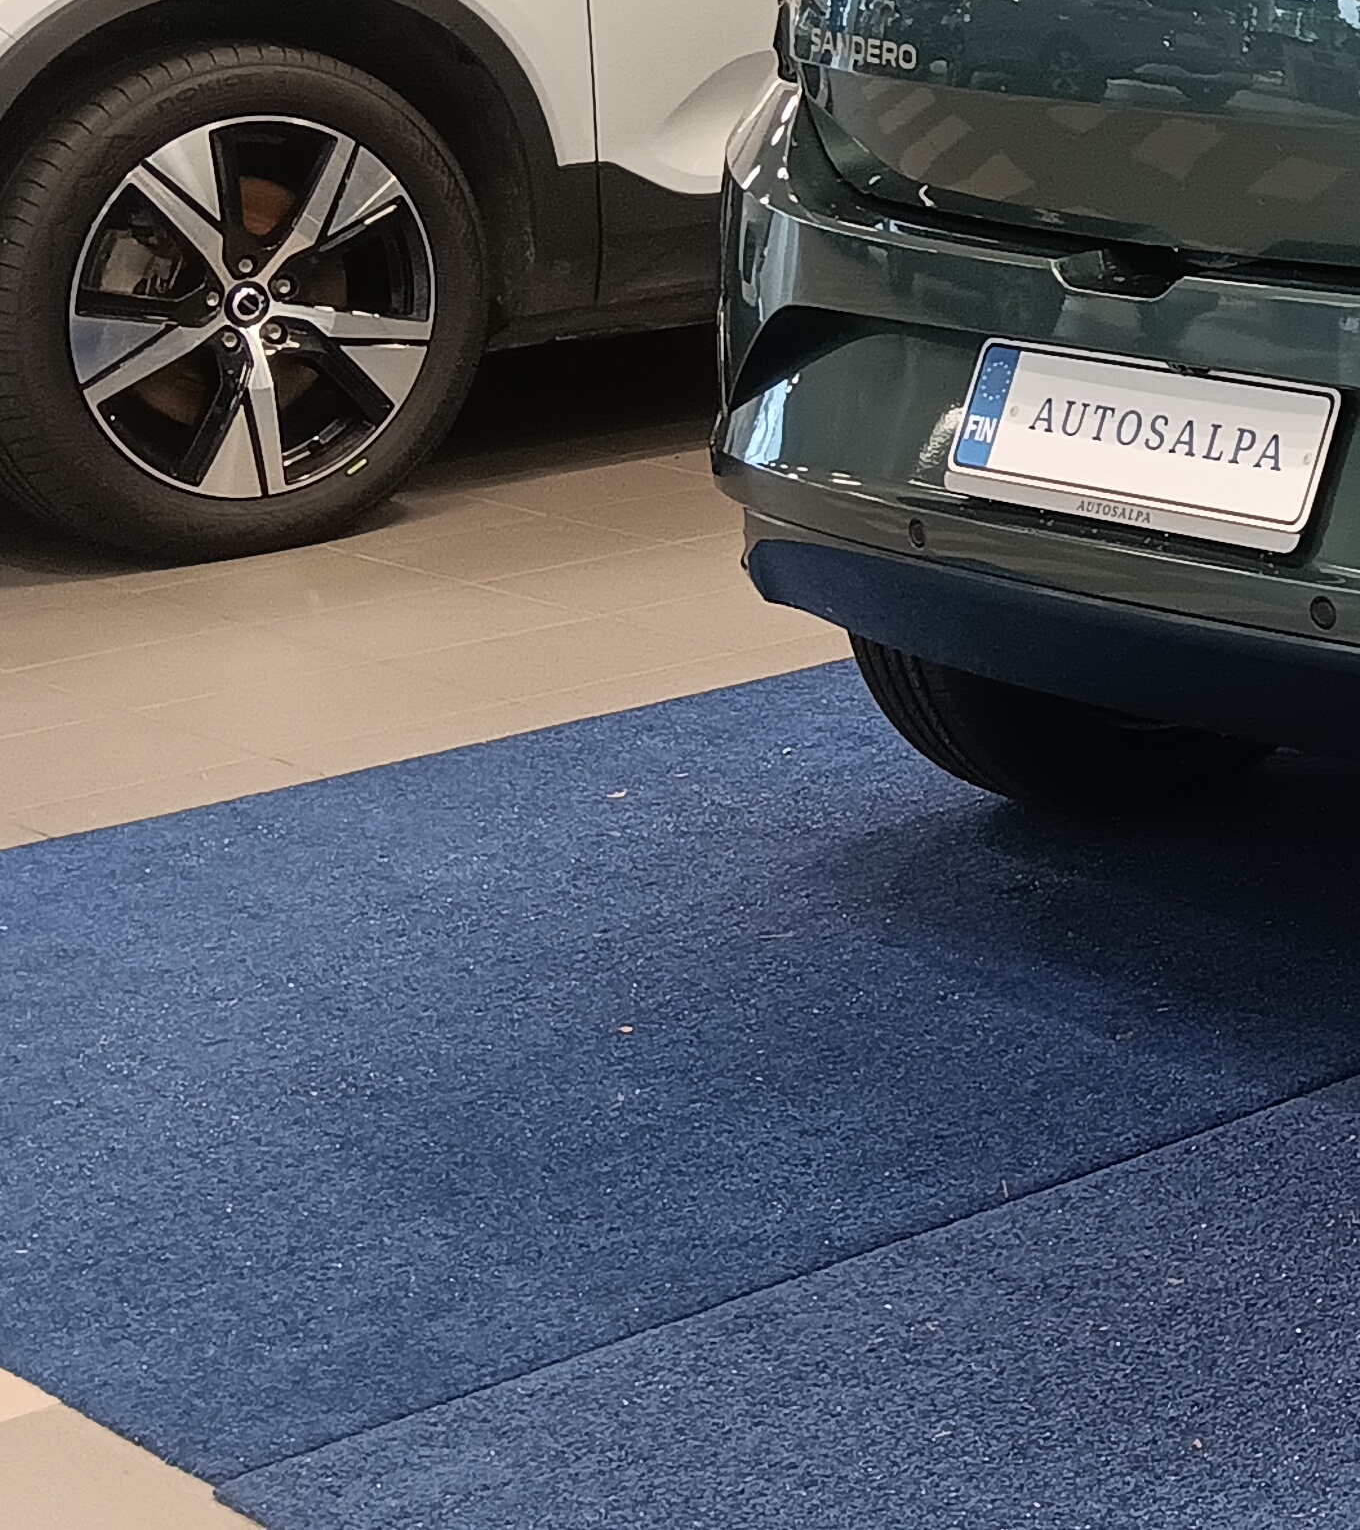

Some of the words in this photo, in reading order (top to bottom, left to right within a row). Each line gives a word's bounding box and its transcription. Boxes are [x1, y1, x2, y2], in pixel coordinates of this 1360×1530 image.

[810, 28, 917, 70] SANDERO
[963, 414, 997, 445] FIN
[1029, 398, 1283, 471] AUTOSALPA
[1075, 499, 1151, 524] AUTOSALPA
